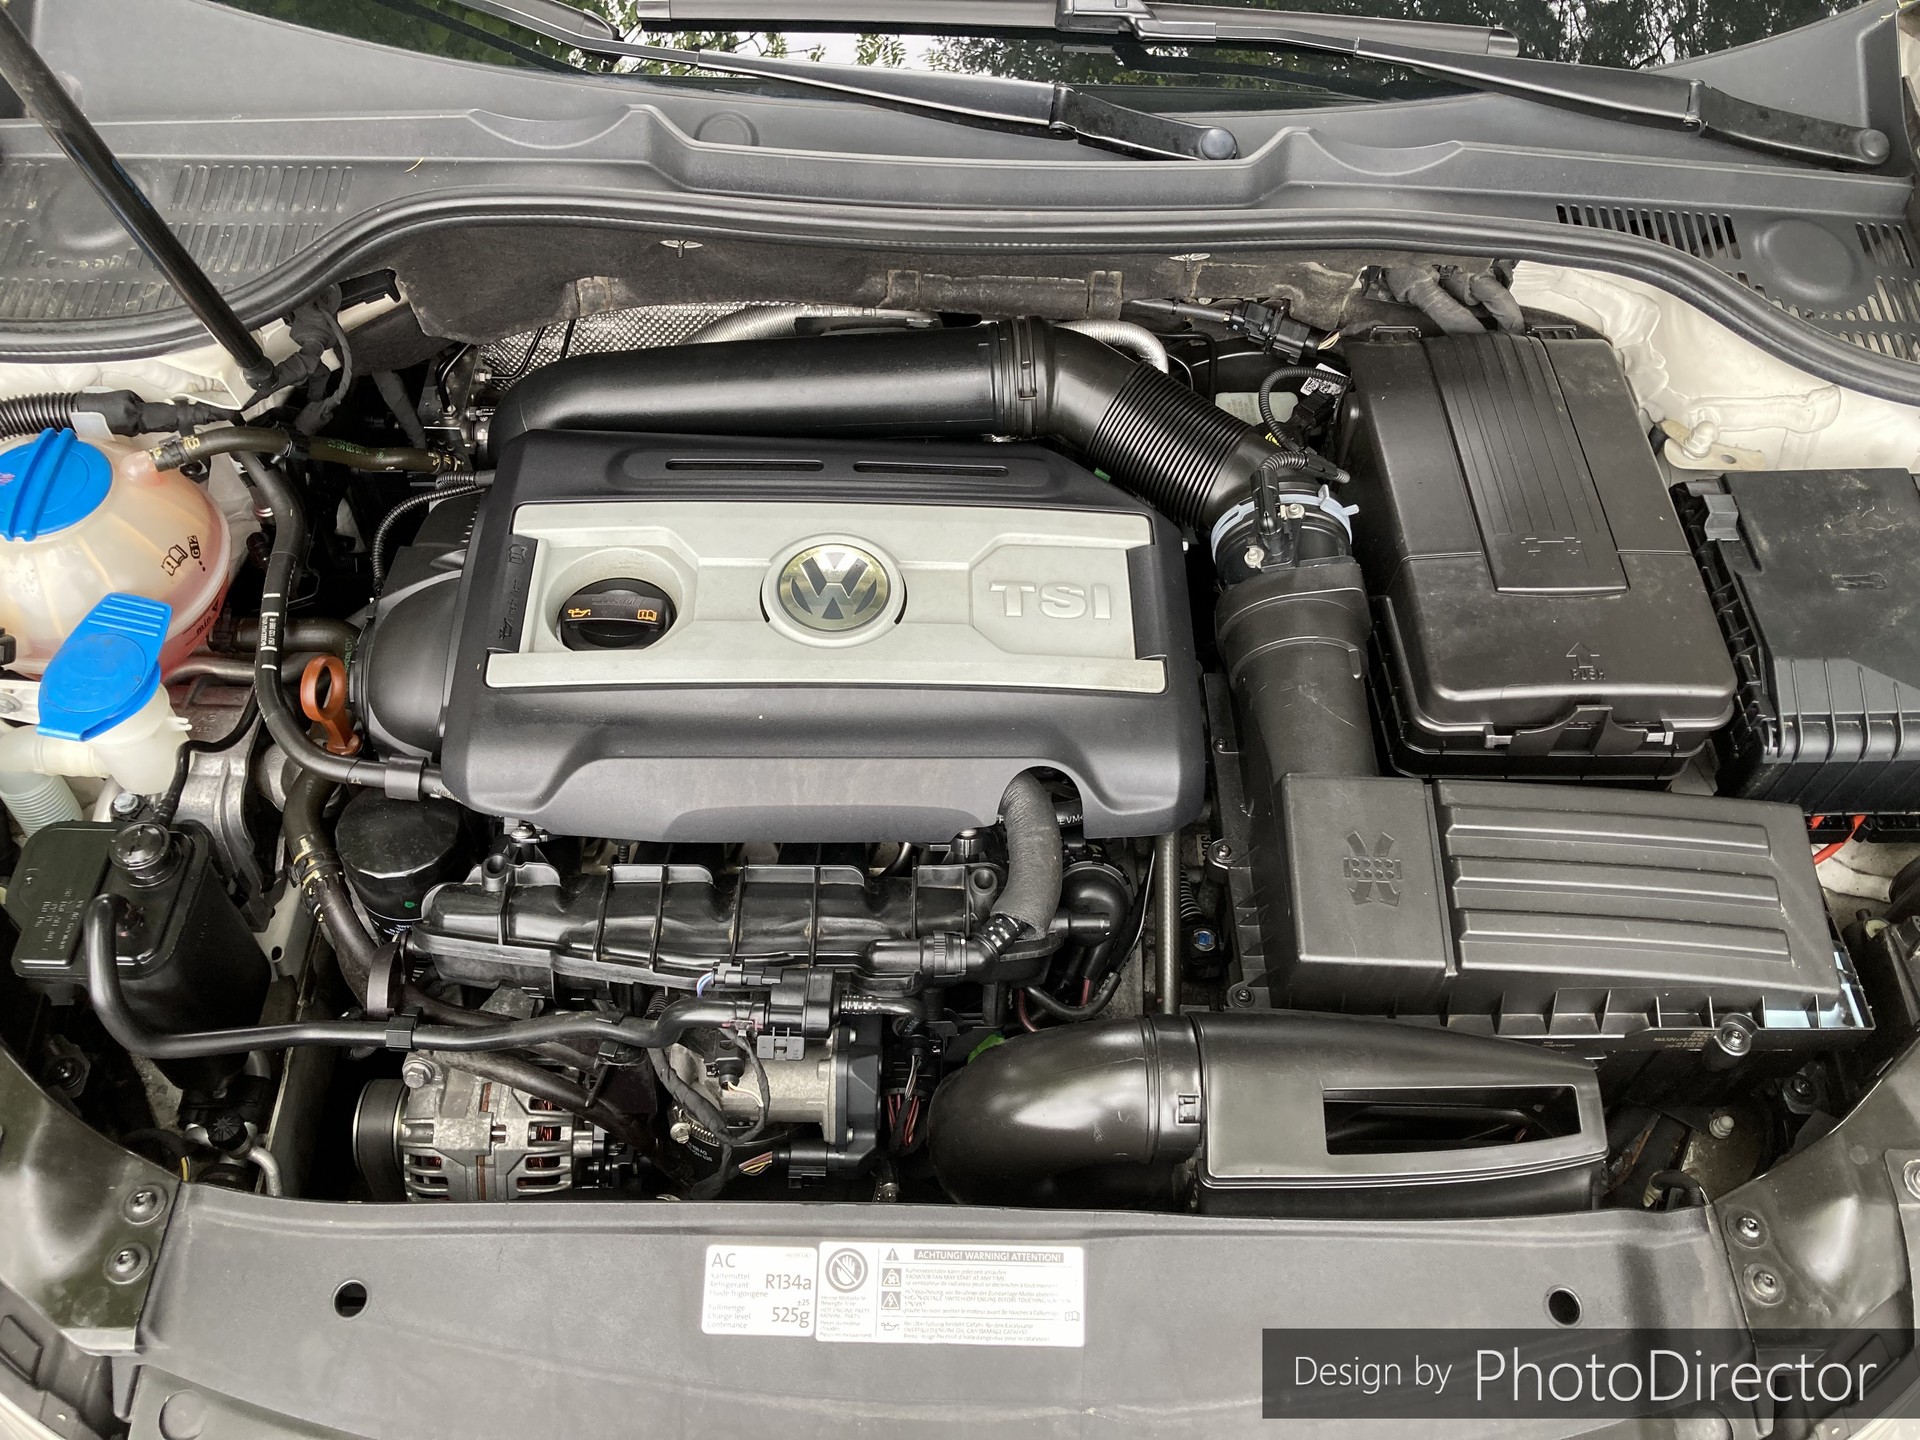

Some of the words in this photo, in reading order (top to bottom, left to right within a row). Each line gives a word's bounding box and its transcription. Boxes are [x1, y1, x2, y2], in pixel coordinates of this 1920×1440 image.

[989, 579, 1112, 620] TSI
[1570, 668, 1606, 681] PUSH
[711, 1252, 736, 1268] AC
[917, 1250, 963, 1260] ACHTUNG!
[965, 1251, 1010, 1261] WARNING!
[1011, 1252, 1061, 1262] ATTENTION!
[765, 1273, 812, 1290] R134a
[771, 1307, 810, 1329] 525g
